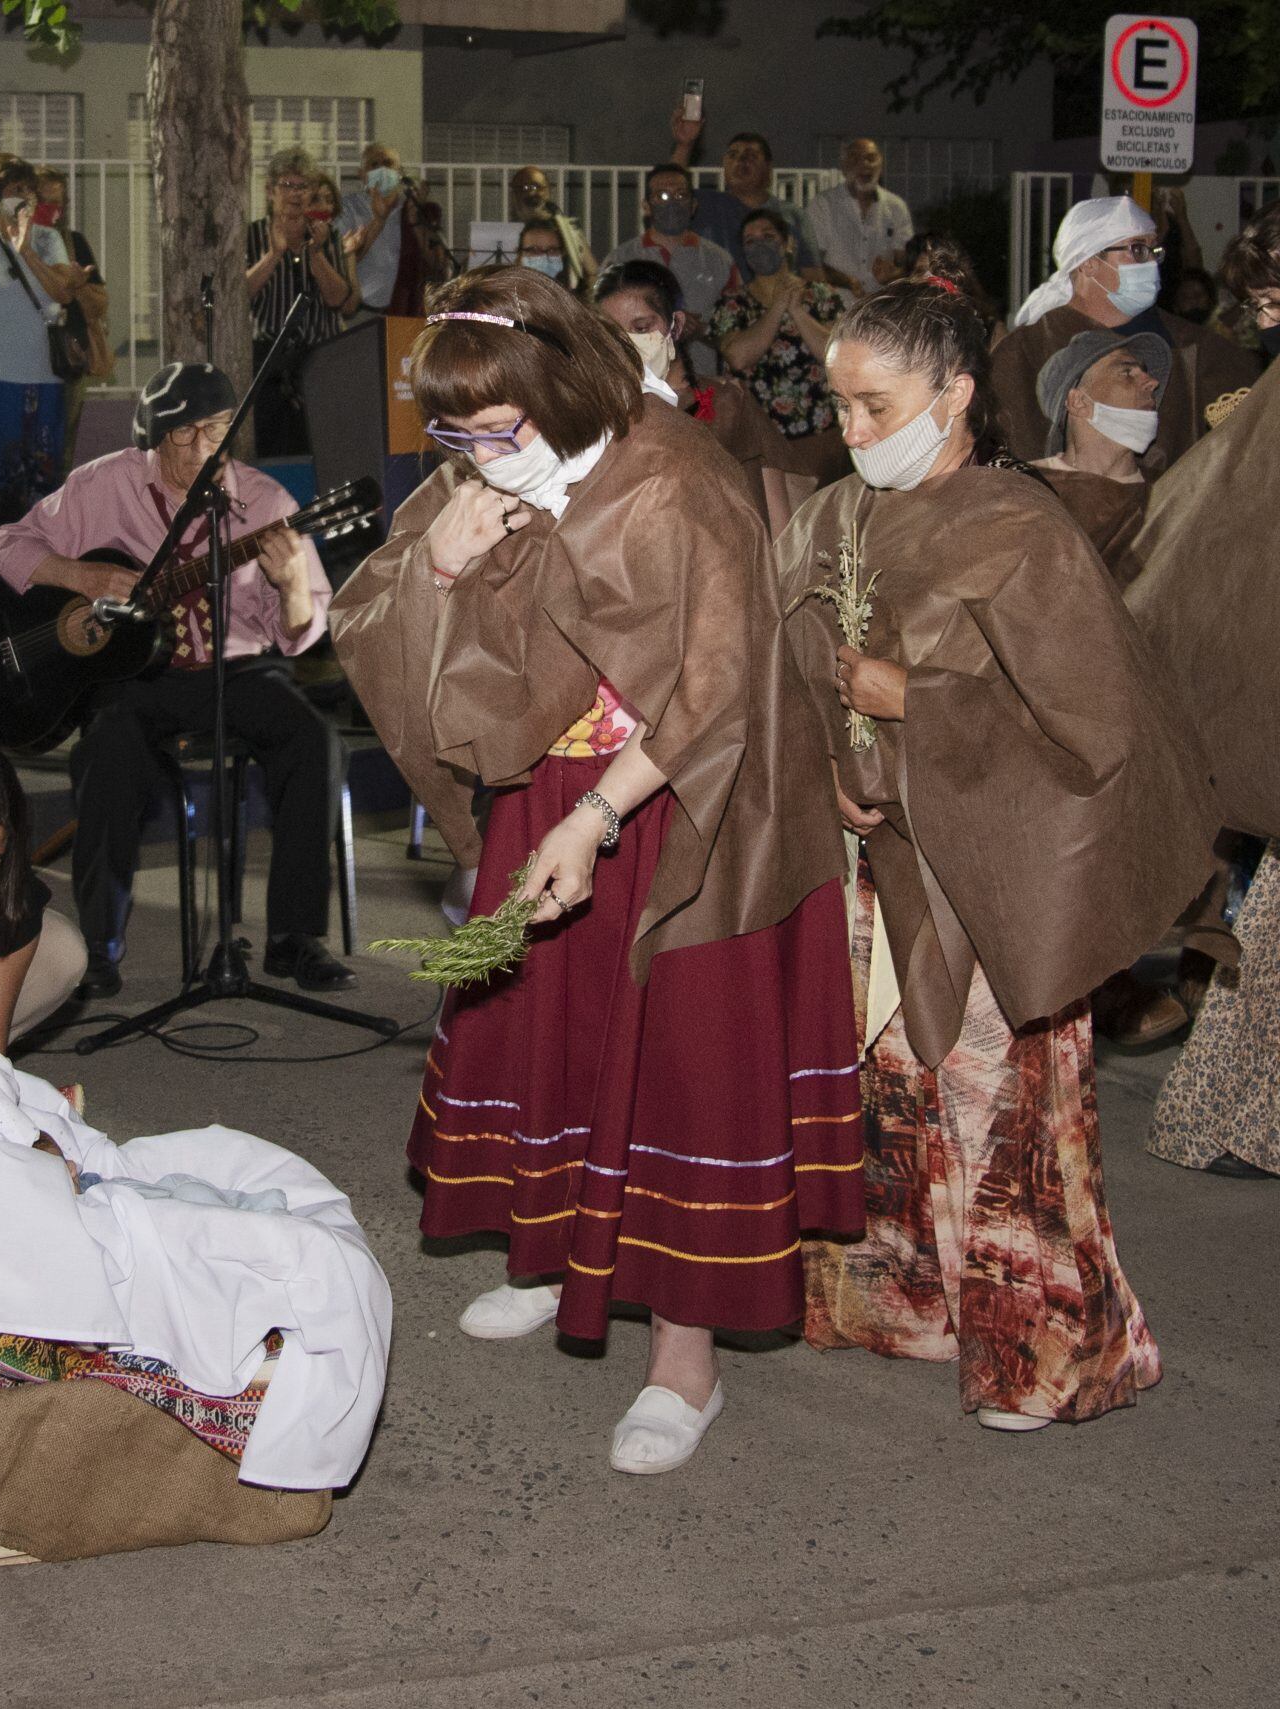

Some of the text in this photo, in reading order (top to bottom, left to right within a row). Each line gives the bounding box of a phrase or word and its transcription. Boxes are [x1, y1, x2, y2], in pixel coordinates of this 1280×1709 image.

[1134, 38, 1169, 90] E
[1105, 109, 1193, 123] ESTACIONAMIENTO
[1122, 125, 1175, 138] EXCLUSIVO
[1117, 141, 1179, 153] BICICLETAS Y
